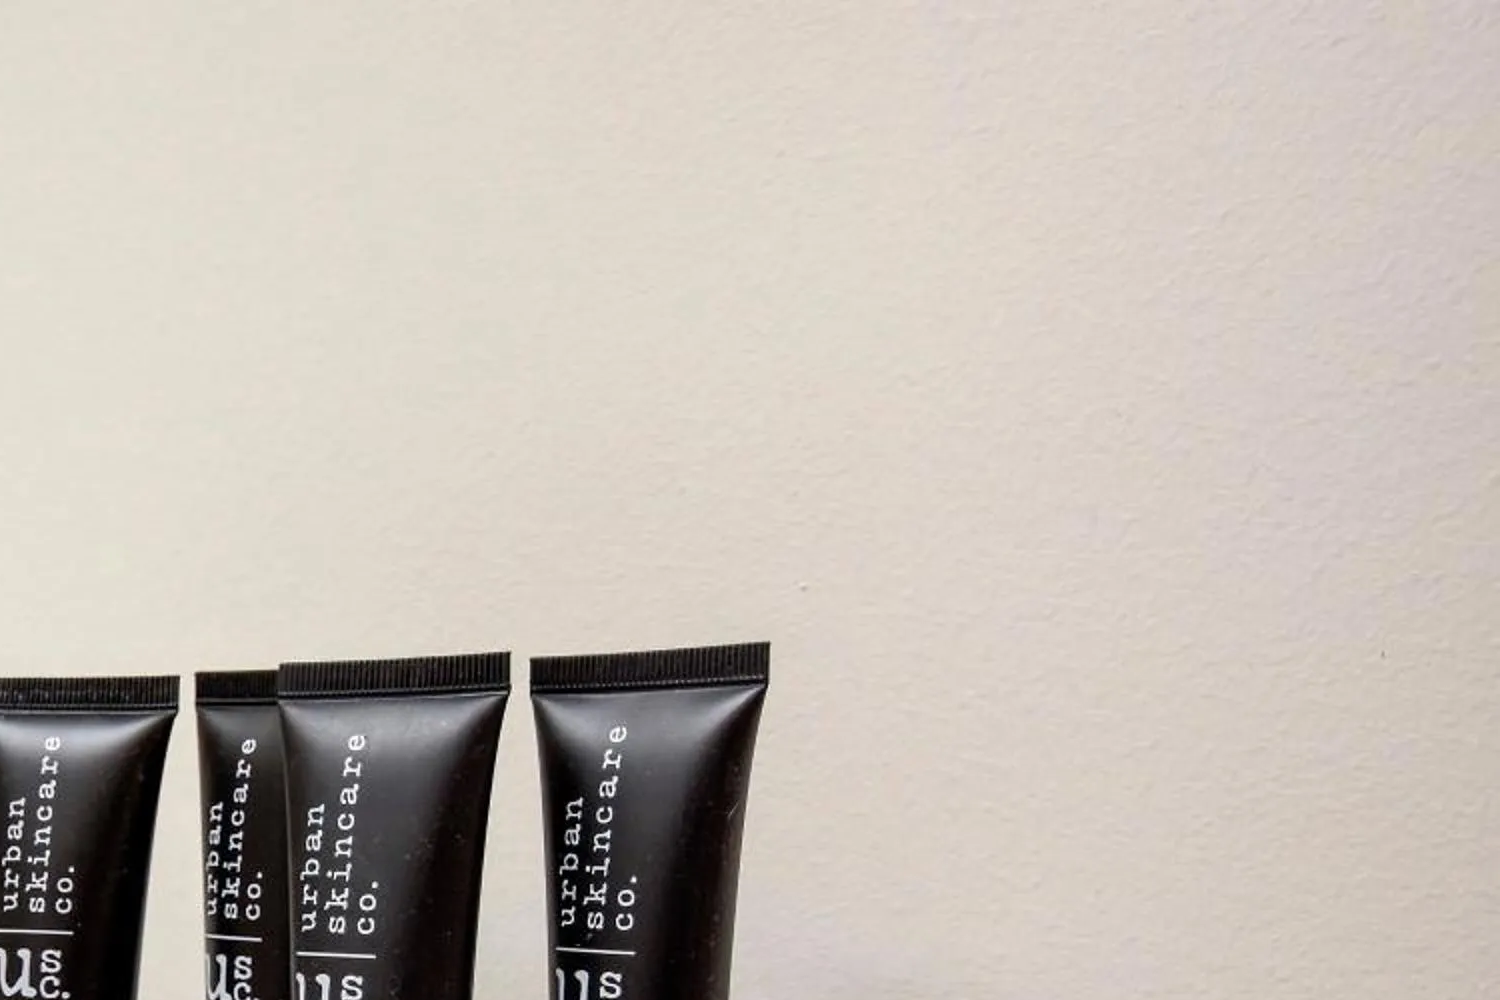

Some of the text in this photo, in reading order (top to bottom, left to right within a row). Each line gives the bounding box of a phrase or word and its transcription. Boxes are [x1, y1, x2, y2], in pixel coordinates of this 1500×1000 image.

[2, 798, 26, 912] urban
[26, 736, 62, 913] skincare
[206, 802, 224, 916] urban
[222, 739, 257, 920] skincare
[300, 804, 325, 932] urban
[324, 734, 366, 934] skincare
[559, 797, 583, 927] urban
[583, 725, 628, 931] skincare
[55, 866, 75, 914] co.
[246, 871, 263, 921] co.
[357, 881, 379, 934] co.
[615, 875, 638, 931] co.
